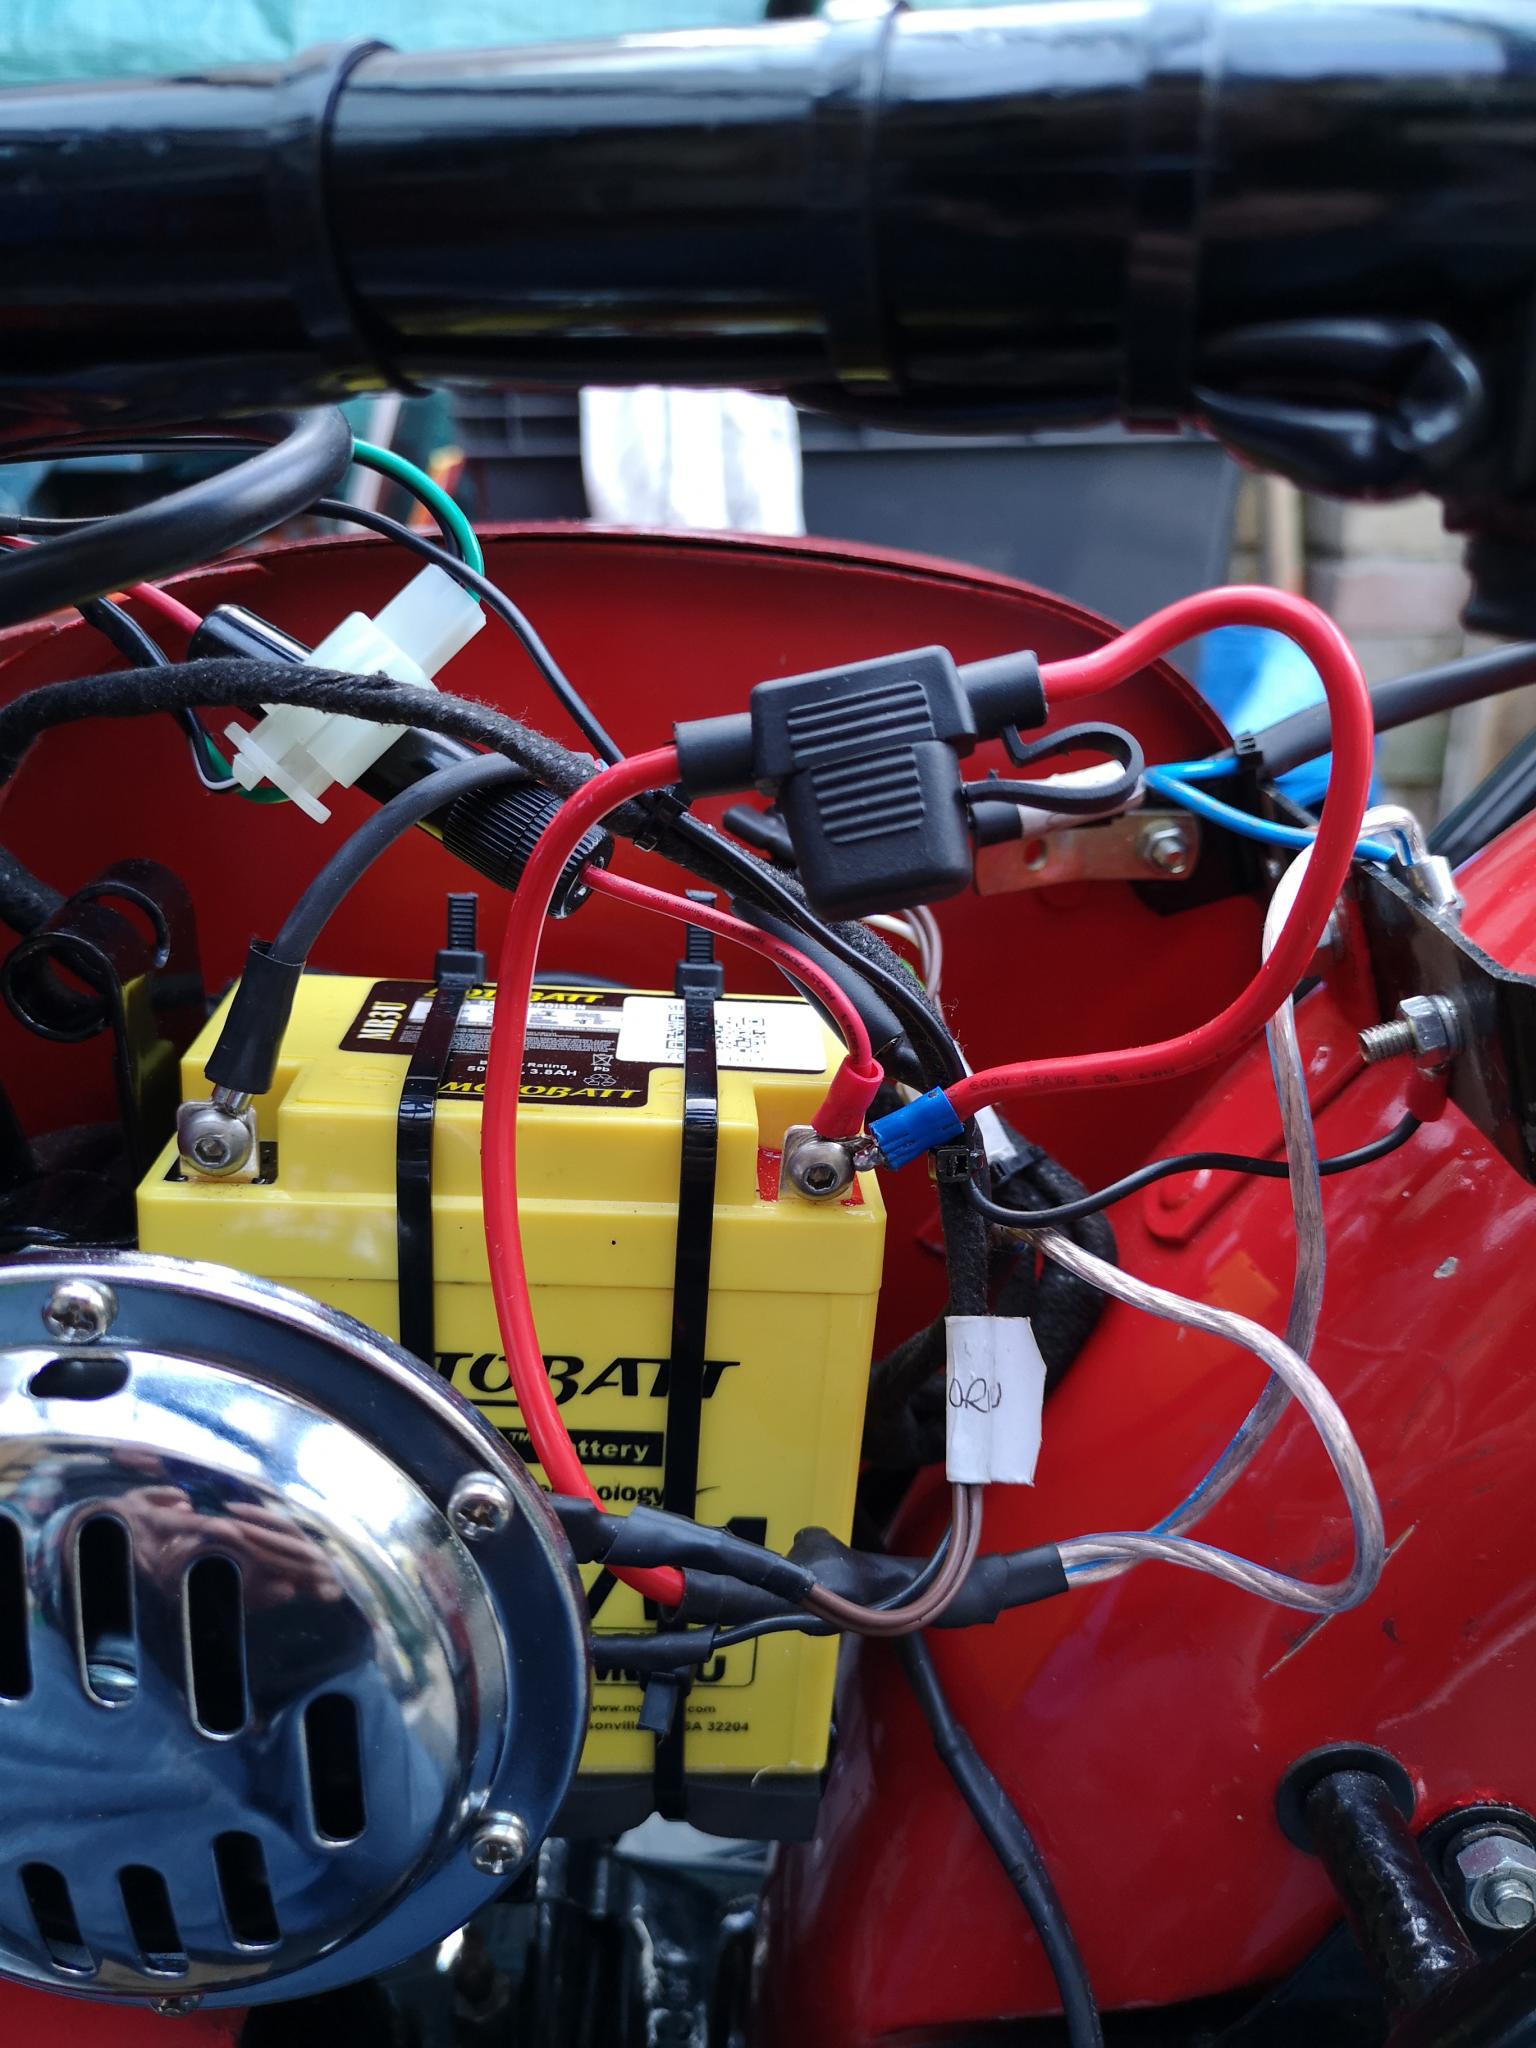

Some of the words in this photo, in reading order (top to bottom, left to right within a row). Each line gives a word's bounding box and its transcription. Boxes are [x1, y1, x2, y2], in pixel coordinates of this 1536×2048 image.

[357, 1000, 408, 1042] MB3U
[527, 1062, 568, 1071] Rating
[530, 1067, 577, 1077] 3.8AH
[574, 1439, 649, 1463] ttery
[707, 1721, 749, 1732] 32204
